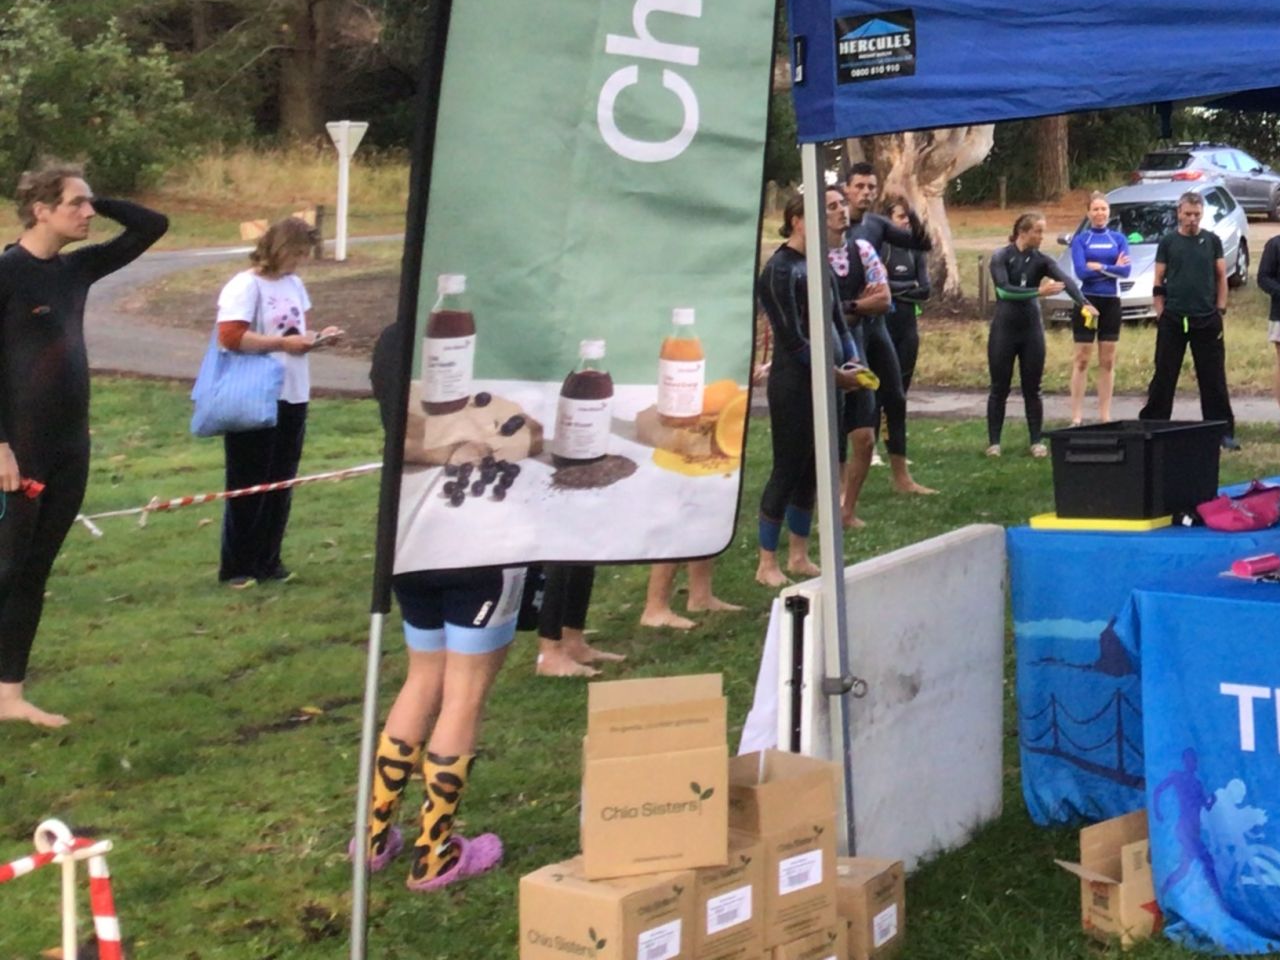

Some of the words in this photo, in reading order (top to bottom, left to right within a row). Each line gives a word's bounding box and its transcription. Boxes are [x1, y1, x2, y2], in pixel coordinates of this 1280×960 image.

[839, 33, 912, 55] HERCULES
[600, 804, 638, 822] Chia
[641, 799, 699, 818] Sisters
